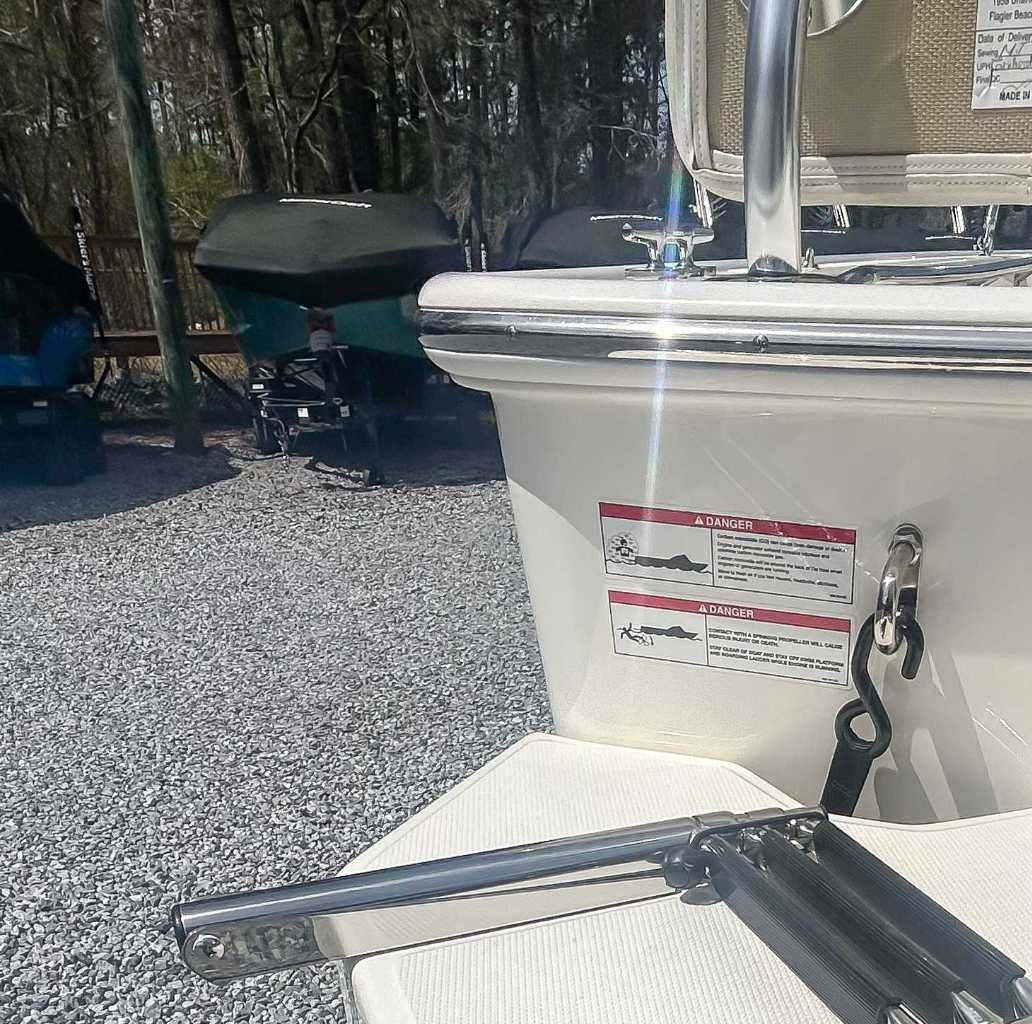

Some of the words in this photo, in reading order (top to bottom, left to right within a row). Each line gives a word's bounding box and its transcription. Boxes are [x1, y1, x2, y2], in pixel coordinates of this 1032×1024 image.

[977, 33, 994, 43] Date
[998, 33, 1005, 42] of
[999, 91, 1021, 101] MADE
[1022, 91, 1031, 99] IN
[706, 516, 753, 530] DANGER
[709, 604, 754, 619] DANGER
